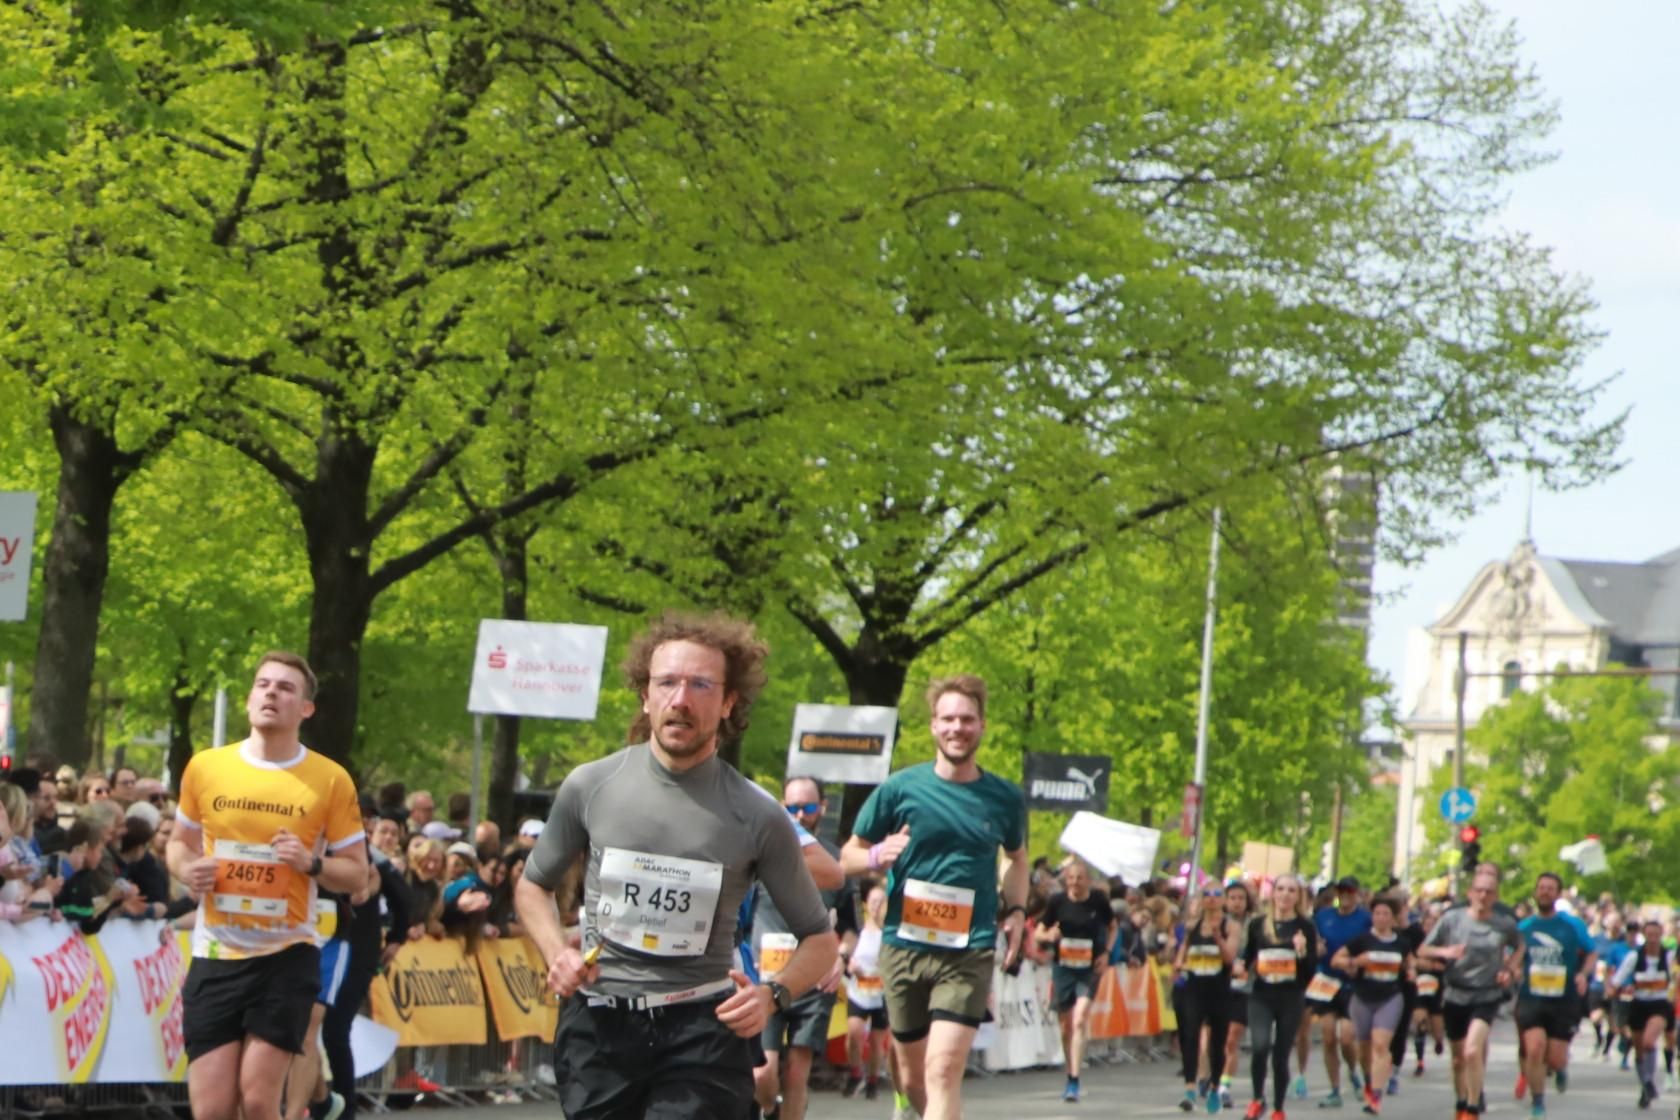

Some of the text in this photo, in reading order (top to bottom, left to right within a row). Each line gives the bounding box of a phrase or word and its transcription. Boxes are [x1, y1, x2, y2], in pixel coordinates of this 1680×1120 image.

[1031, 780, 1087, 800] PUMA
[213, 796, 294, 817] Continental
[226, 863, 275, 884] 24675
[642, 864, 691, 877] MARATHON
[624, 883, 692, 913] R 453
[602, 903, 612, 917] D
[915, 902, 957, 920] 27523
